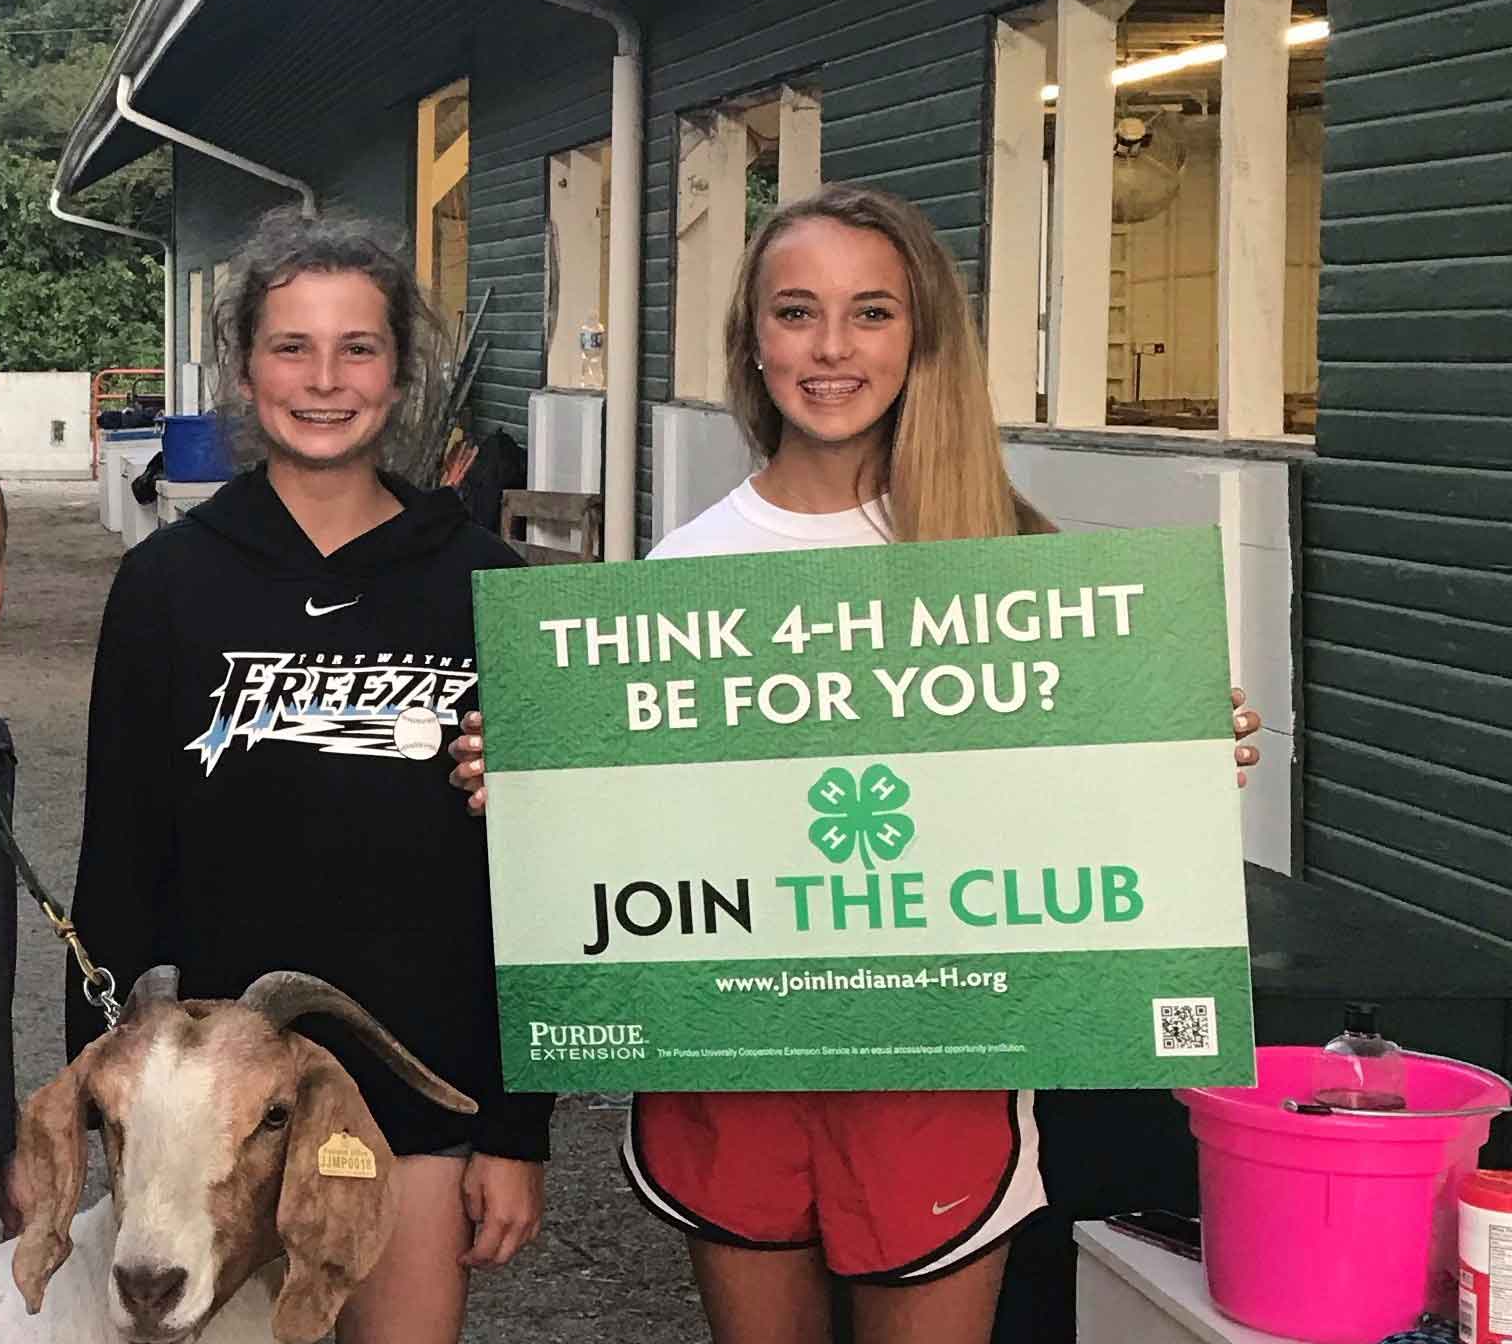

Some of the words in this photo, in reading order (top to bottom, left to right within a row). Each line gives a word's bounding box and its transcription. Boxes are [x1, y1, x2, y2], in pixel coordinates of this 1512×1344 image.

[540, 608, 753, 668] THINK
[771, 599, 884, 654] 4-H
[909, 583, 1145, 647] MIGHT
[297, 653, 366, 666] FORT
[376, 652, 473, 669] WAYNE
[626, 679, 698, 731] BE
[723, 671, 861, 726] FOR
[871, 660, 1060, 719] YOU?
[184, 651, 478, 777] FREEZE
[583, 878, 752, 956] JOIN
[775, 871, 928, 932] THE
[949, 865, 1144, 927] CLUB
[715, 967, 1008, 997] www.JoinIndiana4-H.org
[528, 1021, 645, 1047] PURDUE
[530, 1047, 646, 1061] EXTENSION
[657, 1048, 672, 1058] The
[700, 1047, 737, 1059] University
[783, 1045, 821, 1056] Extension
[821, 1044, 850, 1056] Service
[871, 1045, 893, 1056] equal
[944, 1043, 987, 1057] opportunity
